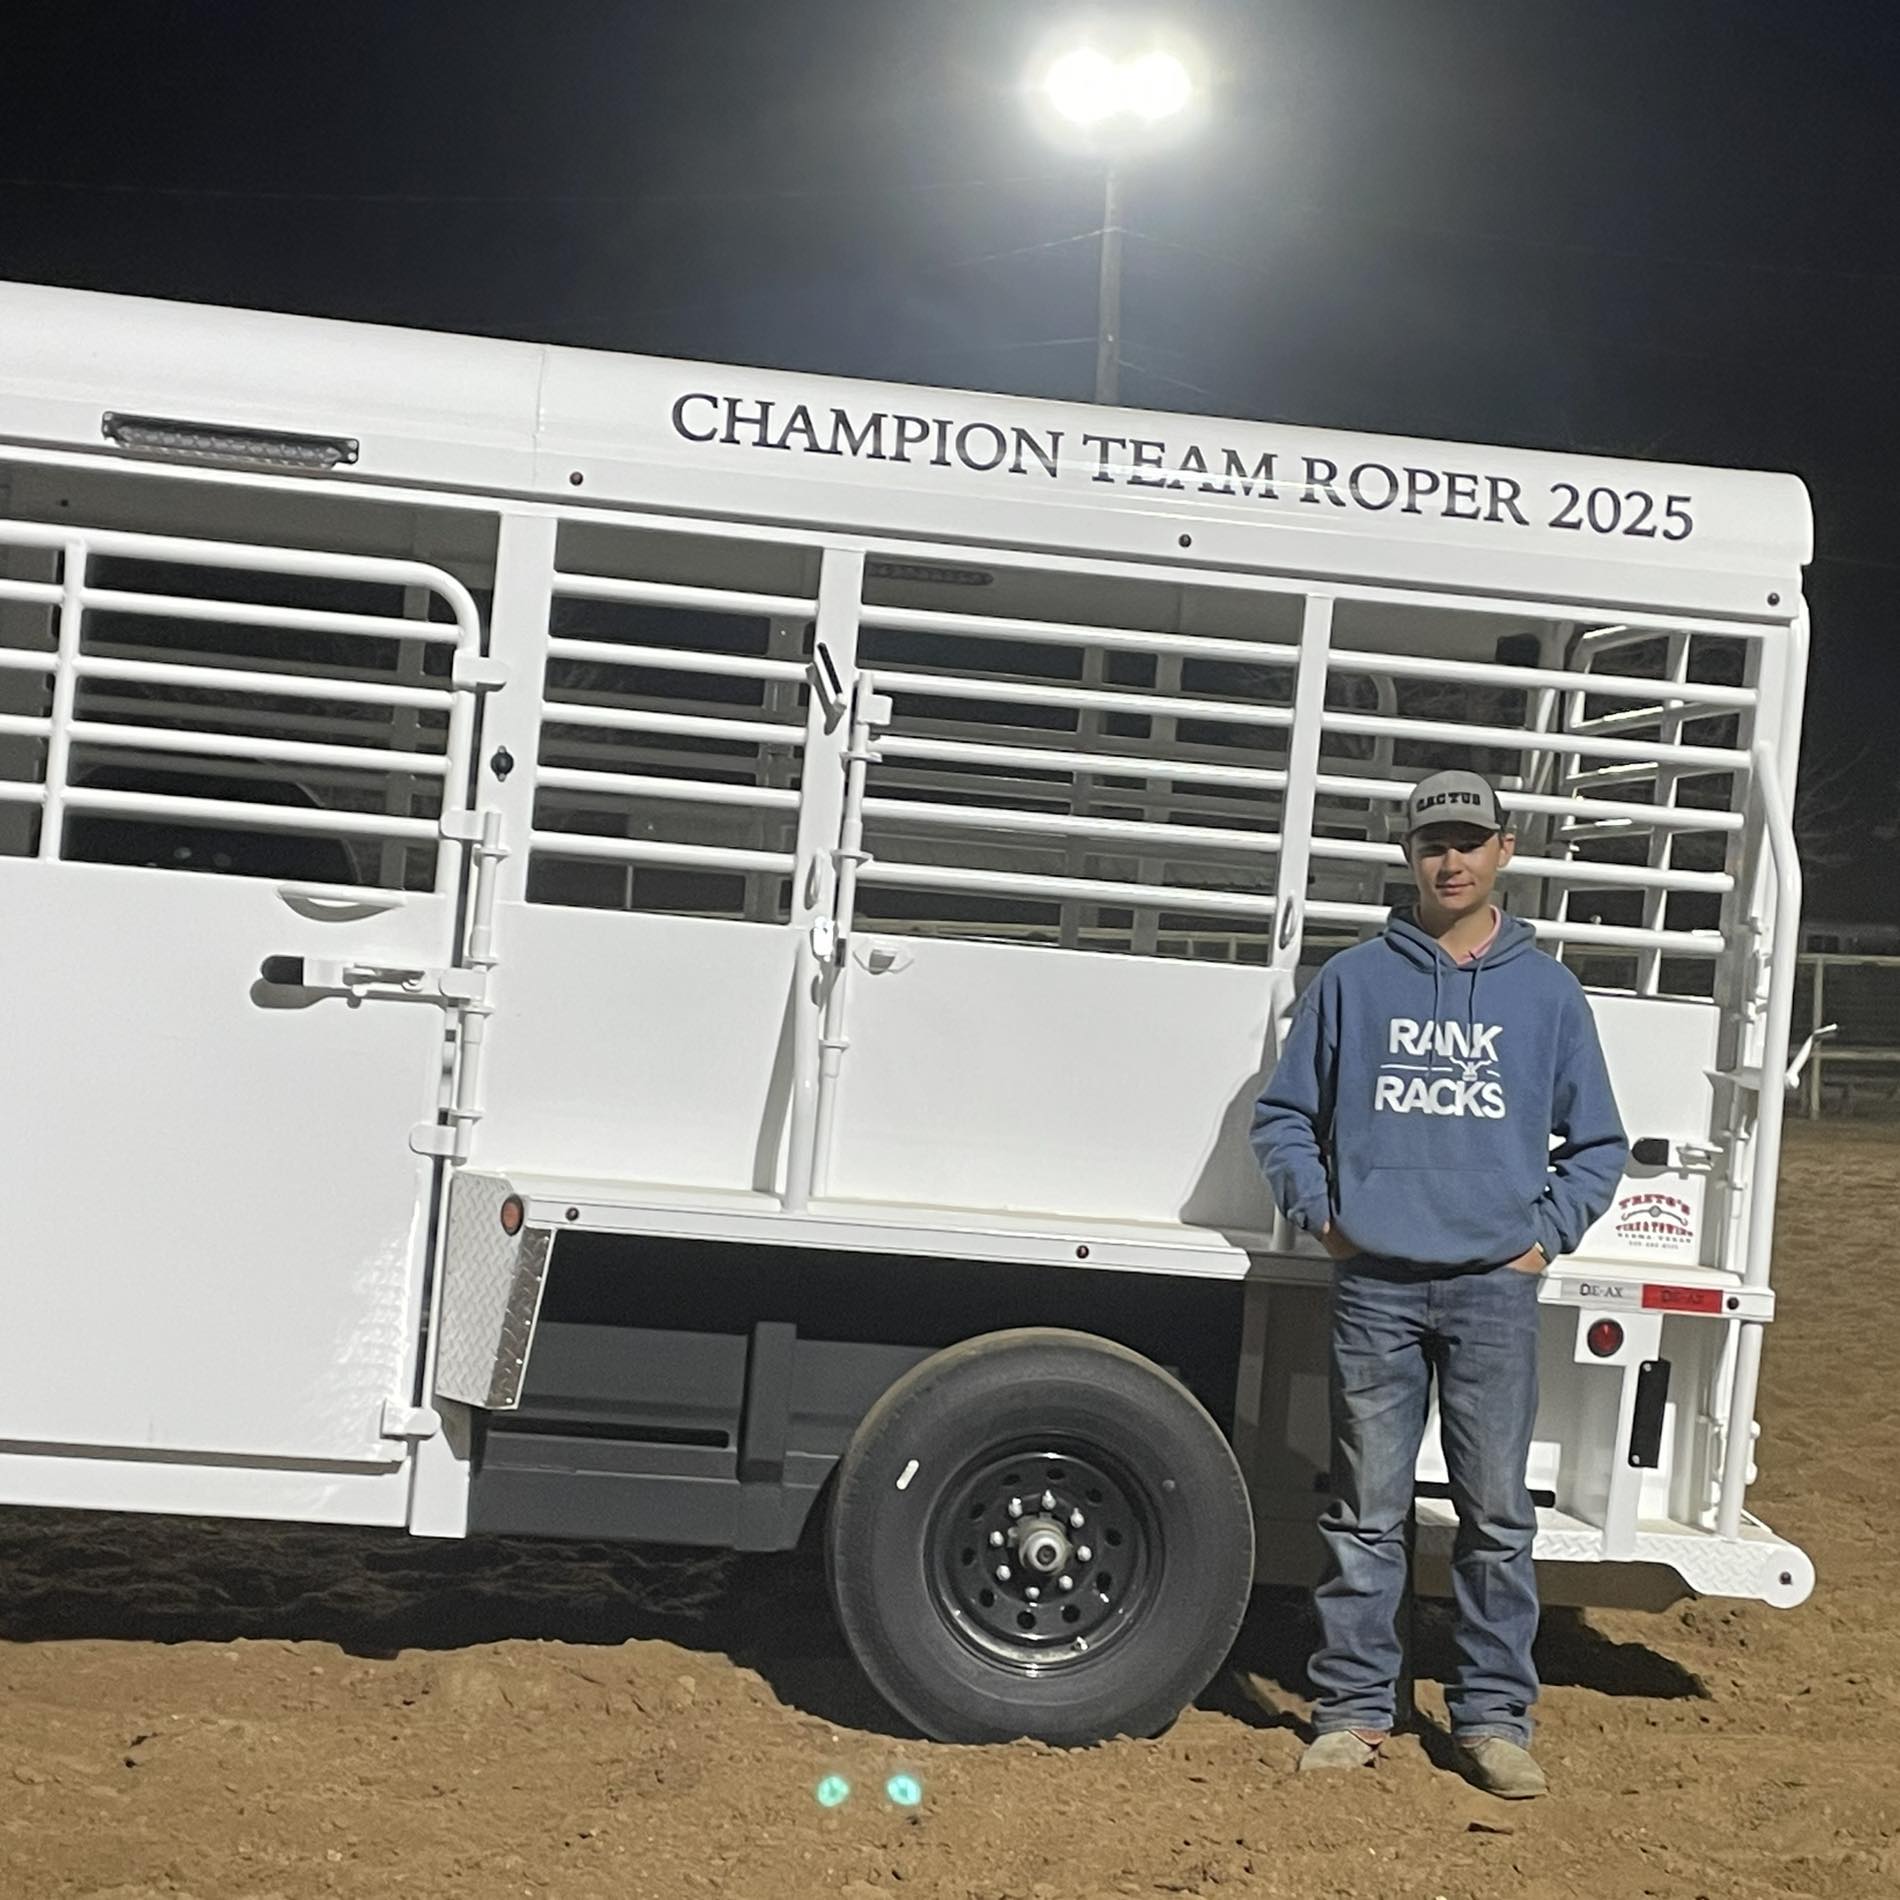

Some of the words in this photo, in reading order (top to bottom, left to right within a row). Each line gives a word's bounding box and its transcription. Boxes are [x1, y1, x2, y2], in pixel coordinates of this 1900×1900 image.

[671, 393, 1065, 478] CHAMPION
[1082, 433, 1279, 500] TEAM
[1300, 455, 1530, 526] ROPER
[1548, 482, 1694, 541] 2025
[1416, 792, 1481, 812] CACTUS
[1389, 1018, 1504, 1062] RANK
[1374, 1075, 1506, 1120] RACKS
